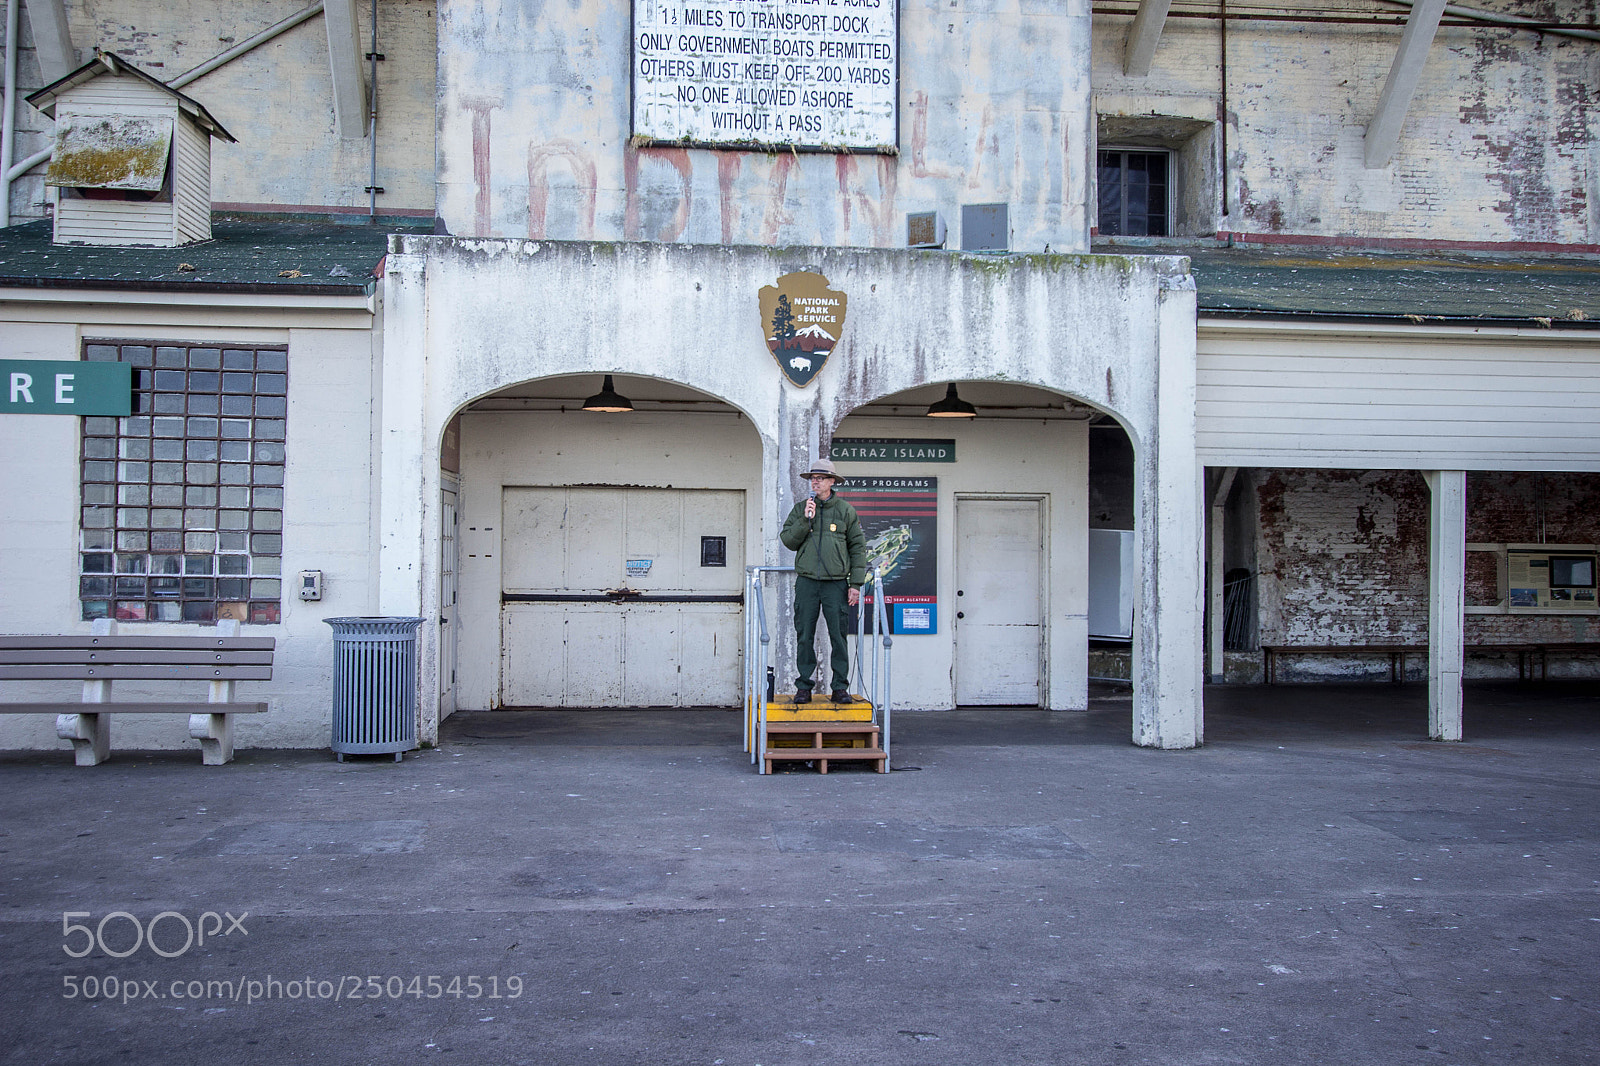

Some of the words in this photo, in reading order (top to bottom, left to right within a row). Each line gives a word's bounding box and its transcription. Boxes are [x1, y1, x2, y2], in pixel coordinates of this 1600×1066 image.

[684, 9, 723, 27] MILES
[729, 11, 745, 28] TO
[751, 12, 828, 31] TRANSPORT
[833, 16, 870, 33] DOCK
[640, 33, 673, 51] ONLY
[678, 35, 768, 55] GOVERNMENT
[773, 39, 814, 57] BOATS
[820, 41, 891, 60] PERMITTED
[640, 59, 695, 77] OTHERS
[701, 61, 739, 79] MUST
[745, 63, 778, 81] KEEP
[785, 64, 810, 82] OFF
[816, 65, 842, 83] 200
[848, 67, 890, 85] YARDS
[677, 85, 697, 103] NO
[702, 86, 729, 104] ONE
[735, 88, 797, 107] ALLOWED
[802, 90, 854, 109] ASHORE
[711, 111, 769, 131] WITHOUT
[776, 114, 784, 131] A
[789, 115, 822, 132] PASS
[794, 297, 840, 306] NATIONAL
[804, 306, 829, 314] PARK
[797, 315, 837, 323] SERVICE
[894, 448, 946, 458] ISLAND
